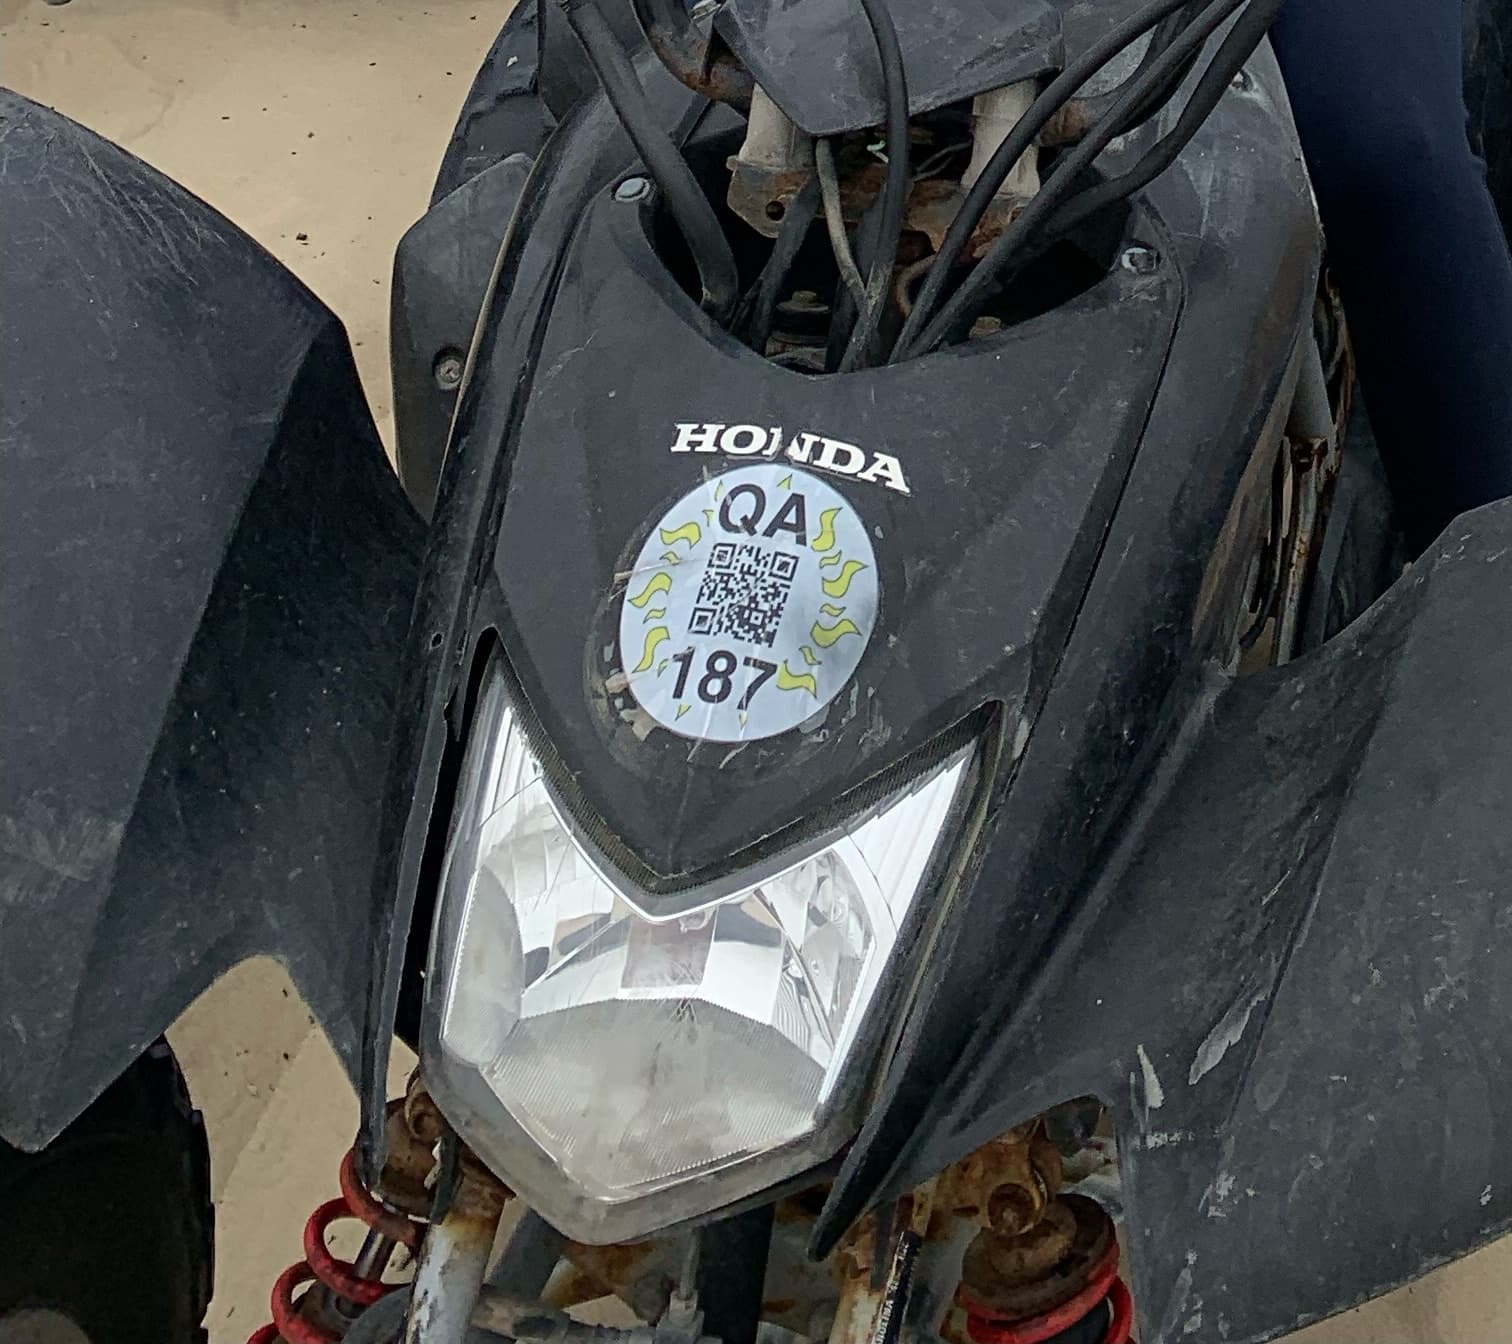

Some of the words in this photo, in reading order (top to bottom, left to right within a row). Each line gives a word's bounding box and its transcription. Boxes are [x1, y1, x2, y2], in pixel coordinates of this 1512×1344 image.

[670, 422, 912, 497] HONDA
[718, 483, 808, 547] QA
[671, 645, 778, 712] 187
